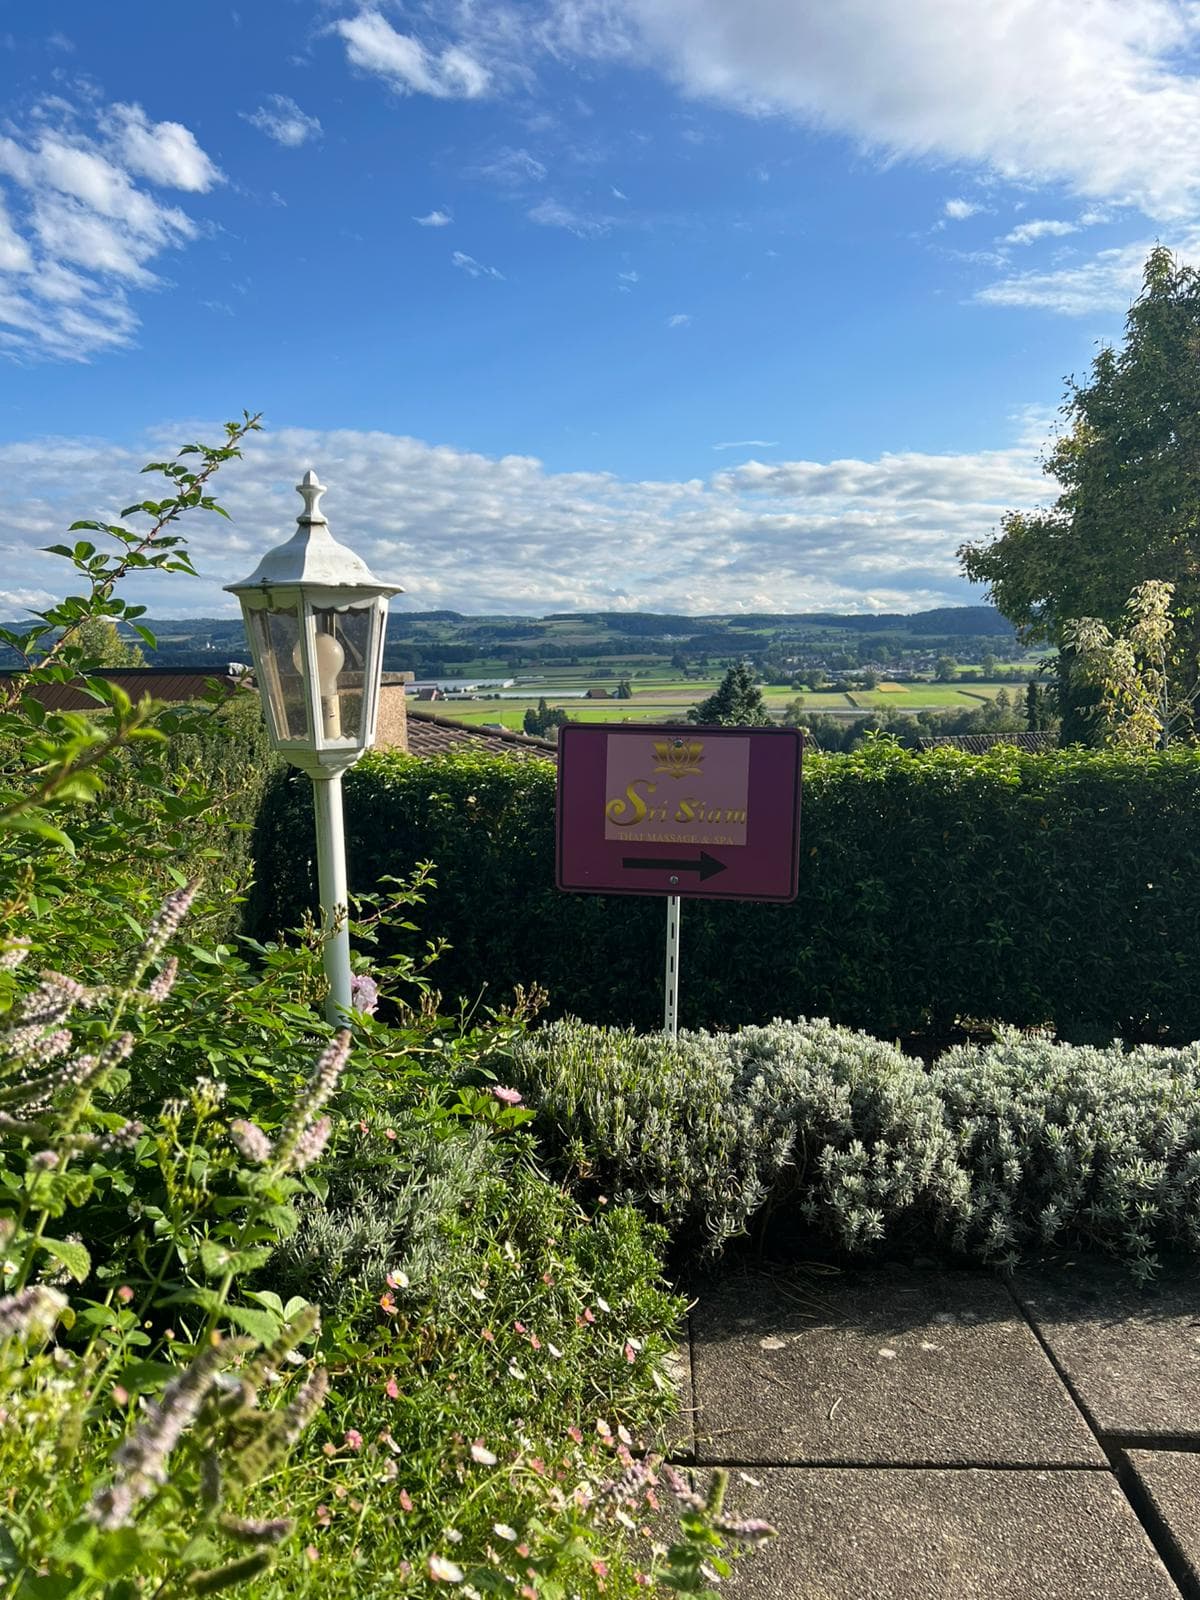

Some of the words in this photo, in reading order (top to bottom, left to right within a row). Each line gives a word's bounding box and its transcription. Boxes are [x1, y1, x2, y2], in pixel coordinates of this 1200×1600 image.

[607, 779, 667, 826] Sri
[675, 797, 746, 824] Siam
[619, 832, 648, 841] THAI
[648, 832, 698, 843] MASSAGE
[702, 834, 710, 843] &
[713, 834, 734, 845] SPA
